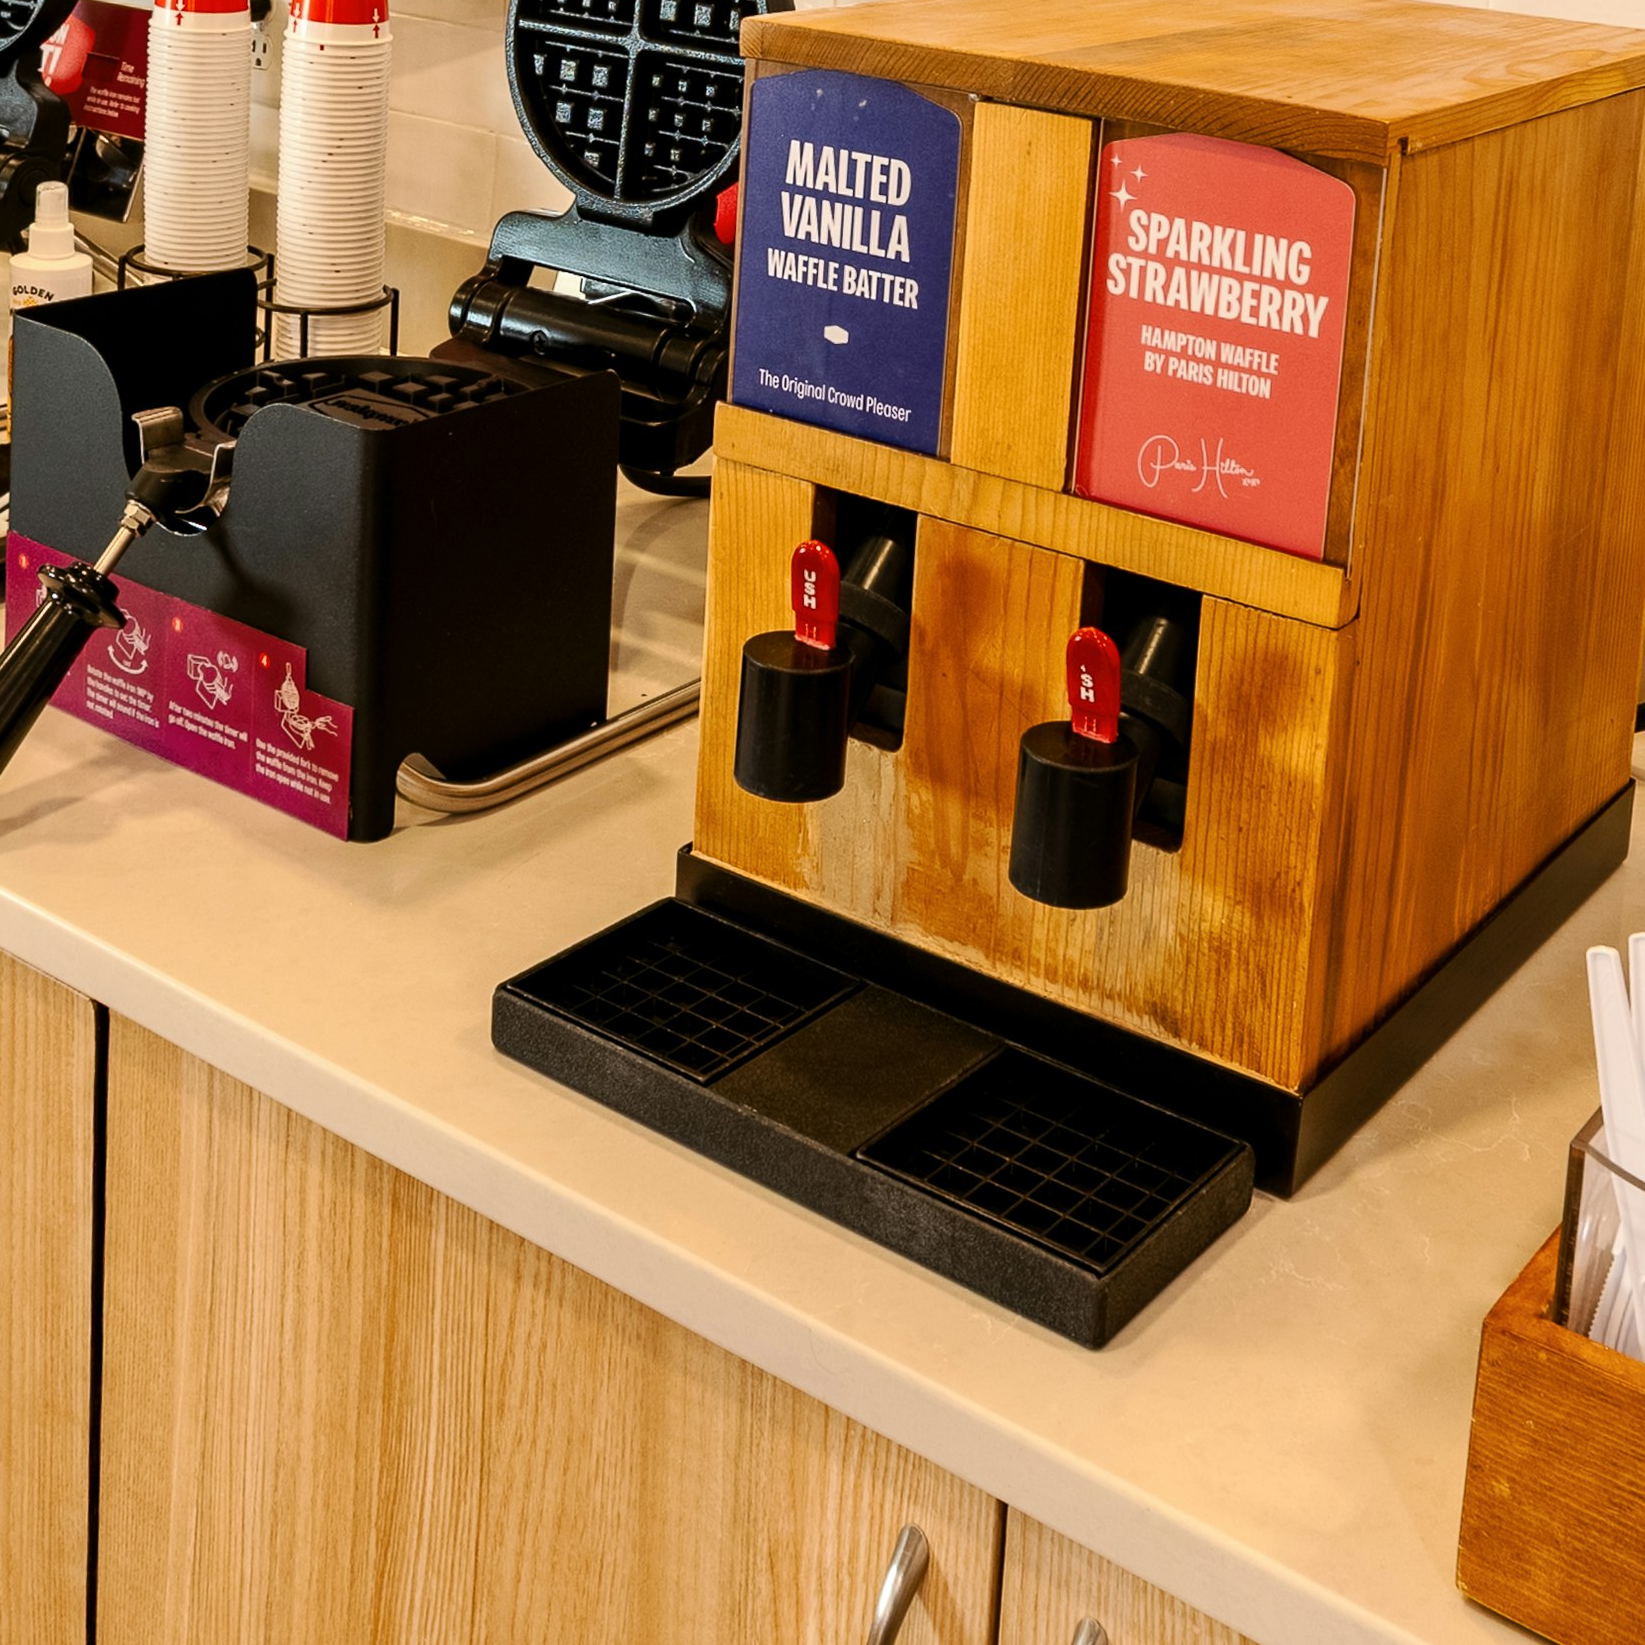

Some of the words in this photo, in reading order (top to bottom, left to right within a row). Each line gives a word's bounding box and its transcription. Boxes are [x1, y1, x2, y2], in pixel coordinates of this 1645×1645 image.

[785, 139, 912, 207] MALTED
[781, 191, 910, 263] VANILLA
[1127, 209, 1312, 286] SPARKLING
[13, 285, 54, 301] GOLDEN
[767, 247, 838, 292] WAFFLE
[843, 264, 919, 310] BATTER
[1106, 253, 1329, 339] STRAWBERRY
[1140, 324, 1216, 361] HAMPTON
[1220, 341, 1279, 375] WAFFLE
[1144, 351, 1163, 374] BY
[1167, 356, 1213, 386] PARIS
[1216, 370, 1271, 400] HILTON
[759, 368, 780, 389] The
[782, 374, 826, 401] Original
[828, 387, 864, 411] Crowd
[866, 397, 911, 423] Pleaser
[1137, 434, 1197, 488] Paris
[1191, 437, 1254, 498] Hilton
[1080, 664, 1094, 703] SH
